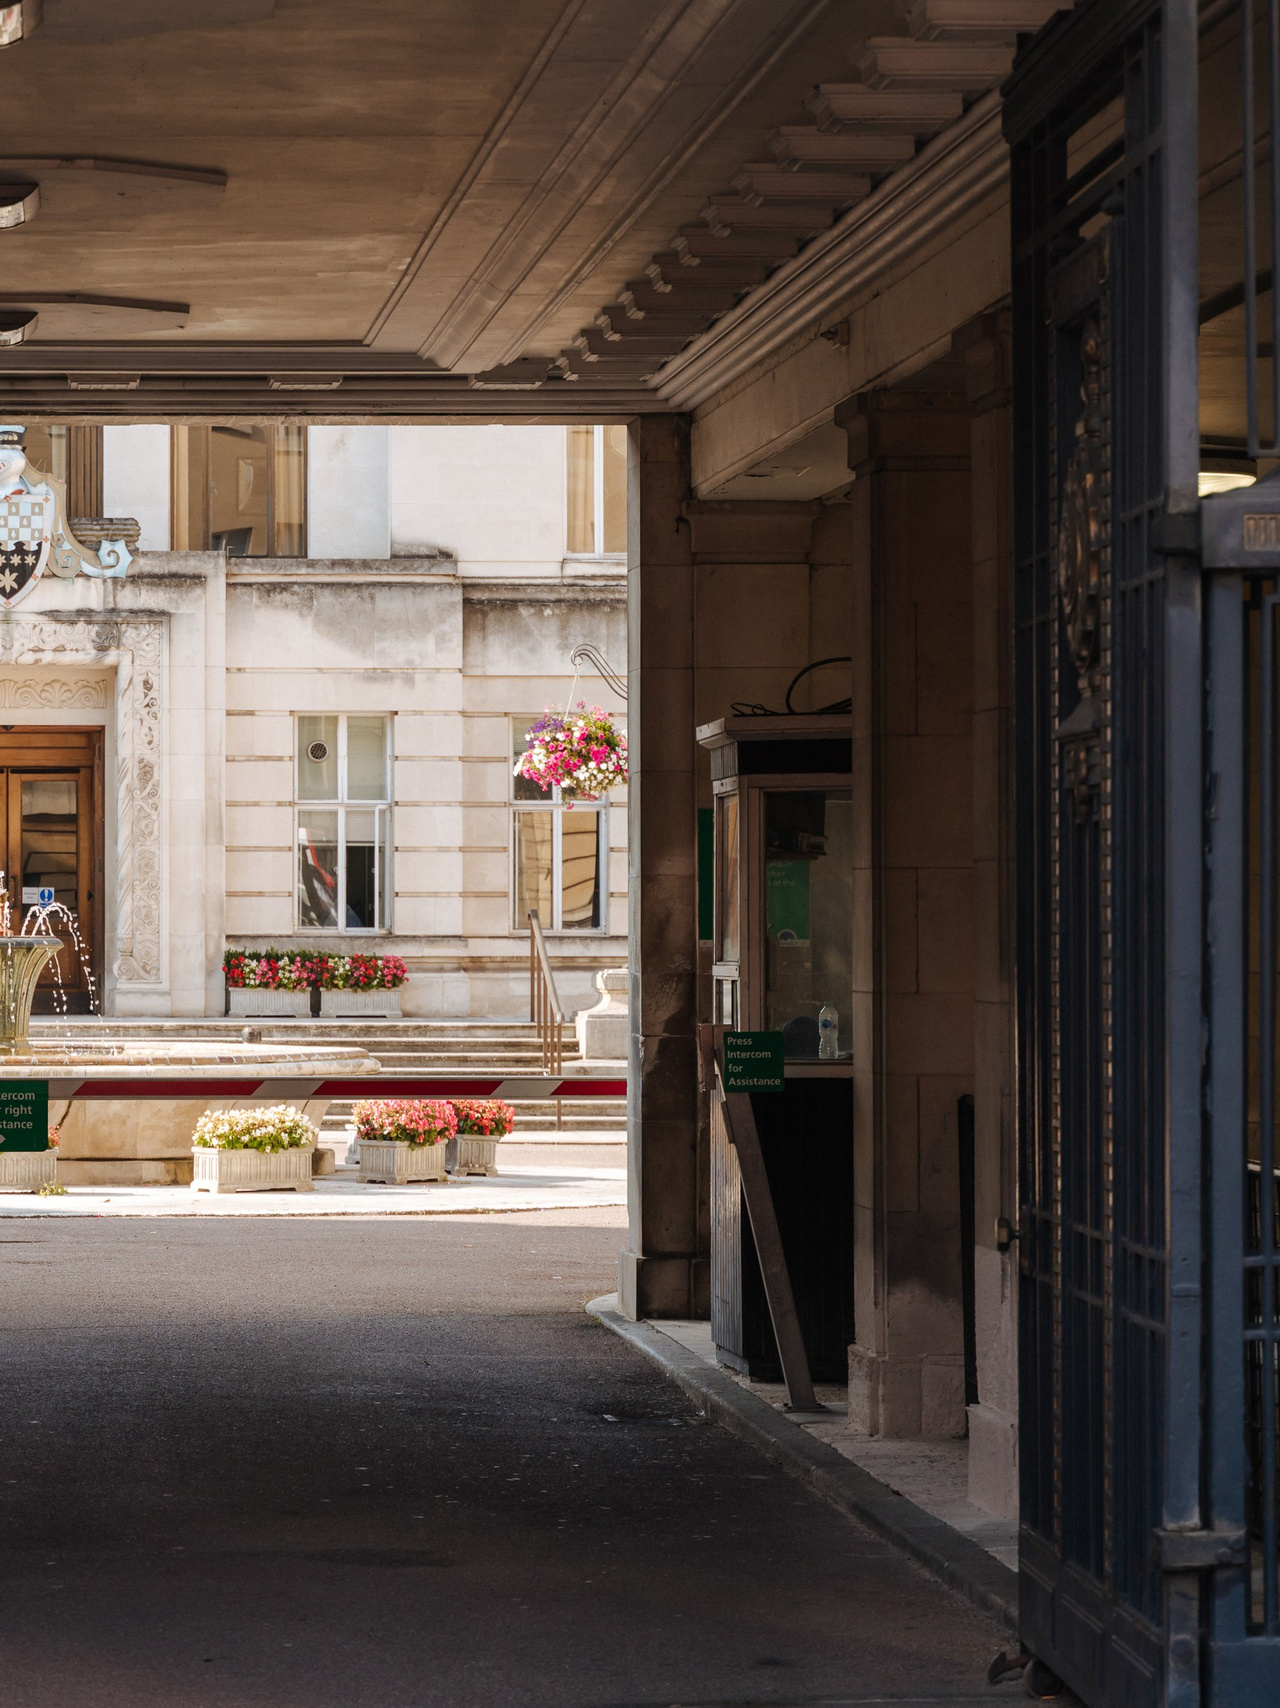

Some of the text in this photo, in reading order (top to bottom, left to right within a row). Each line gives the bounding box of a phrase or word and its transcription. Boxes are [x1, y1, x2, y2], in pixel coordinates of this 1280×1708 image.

[727, 1037, 752, 1045] Press
[727, 1051, 771, 1059] Intercom
[728, 1064, 744, 1073] for
[728, 1077, 781, 1086] Assistance
[4, 1105, 33, 1117] right
